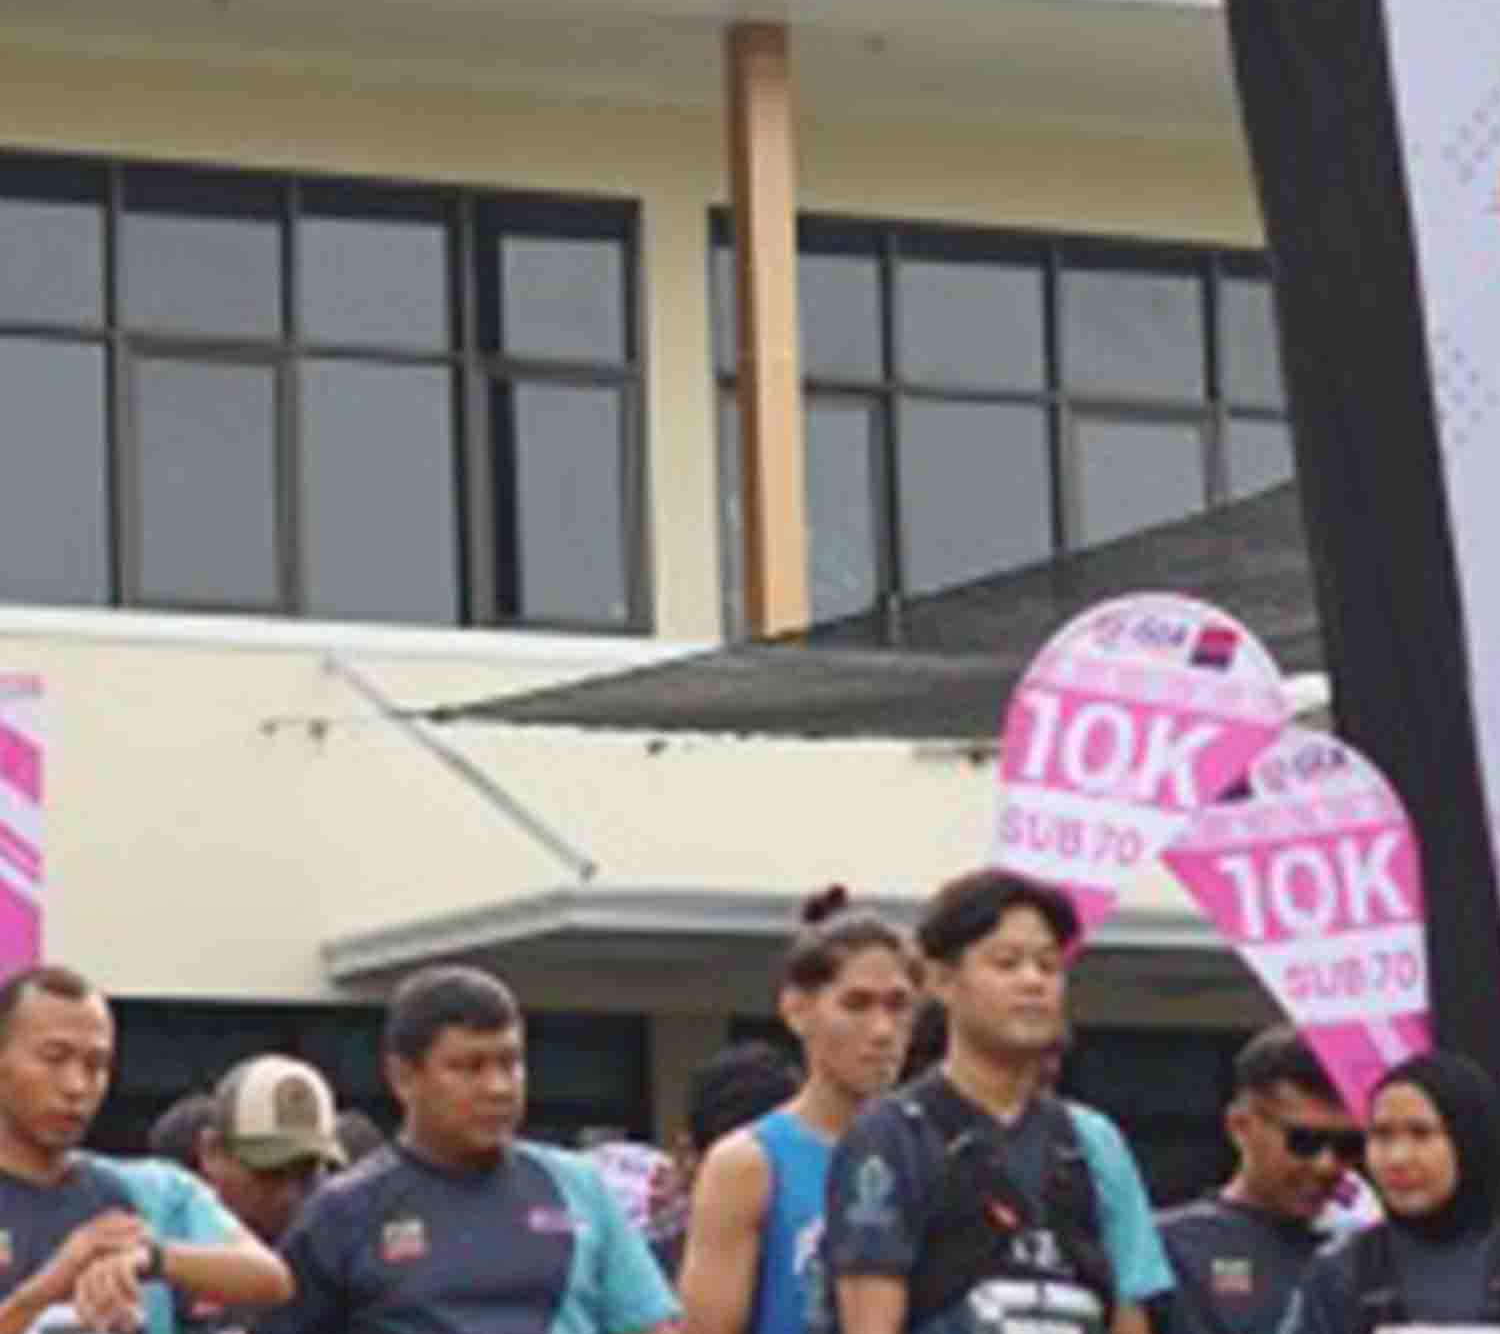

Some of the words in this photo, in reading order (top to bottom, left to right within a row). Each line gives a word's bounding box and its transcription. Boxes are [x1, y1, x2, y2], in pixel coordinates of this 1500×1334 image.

[1018, 695, 1226, 809] 10K
[1002, 805, 1083, 859] SUB
[1091, 827, 1142, 865] 70
[1212, 829, 1411, 939] 10K
[1284, 957, 1364, 999] SUB
[1368, 950, 1422, 993] 70
